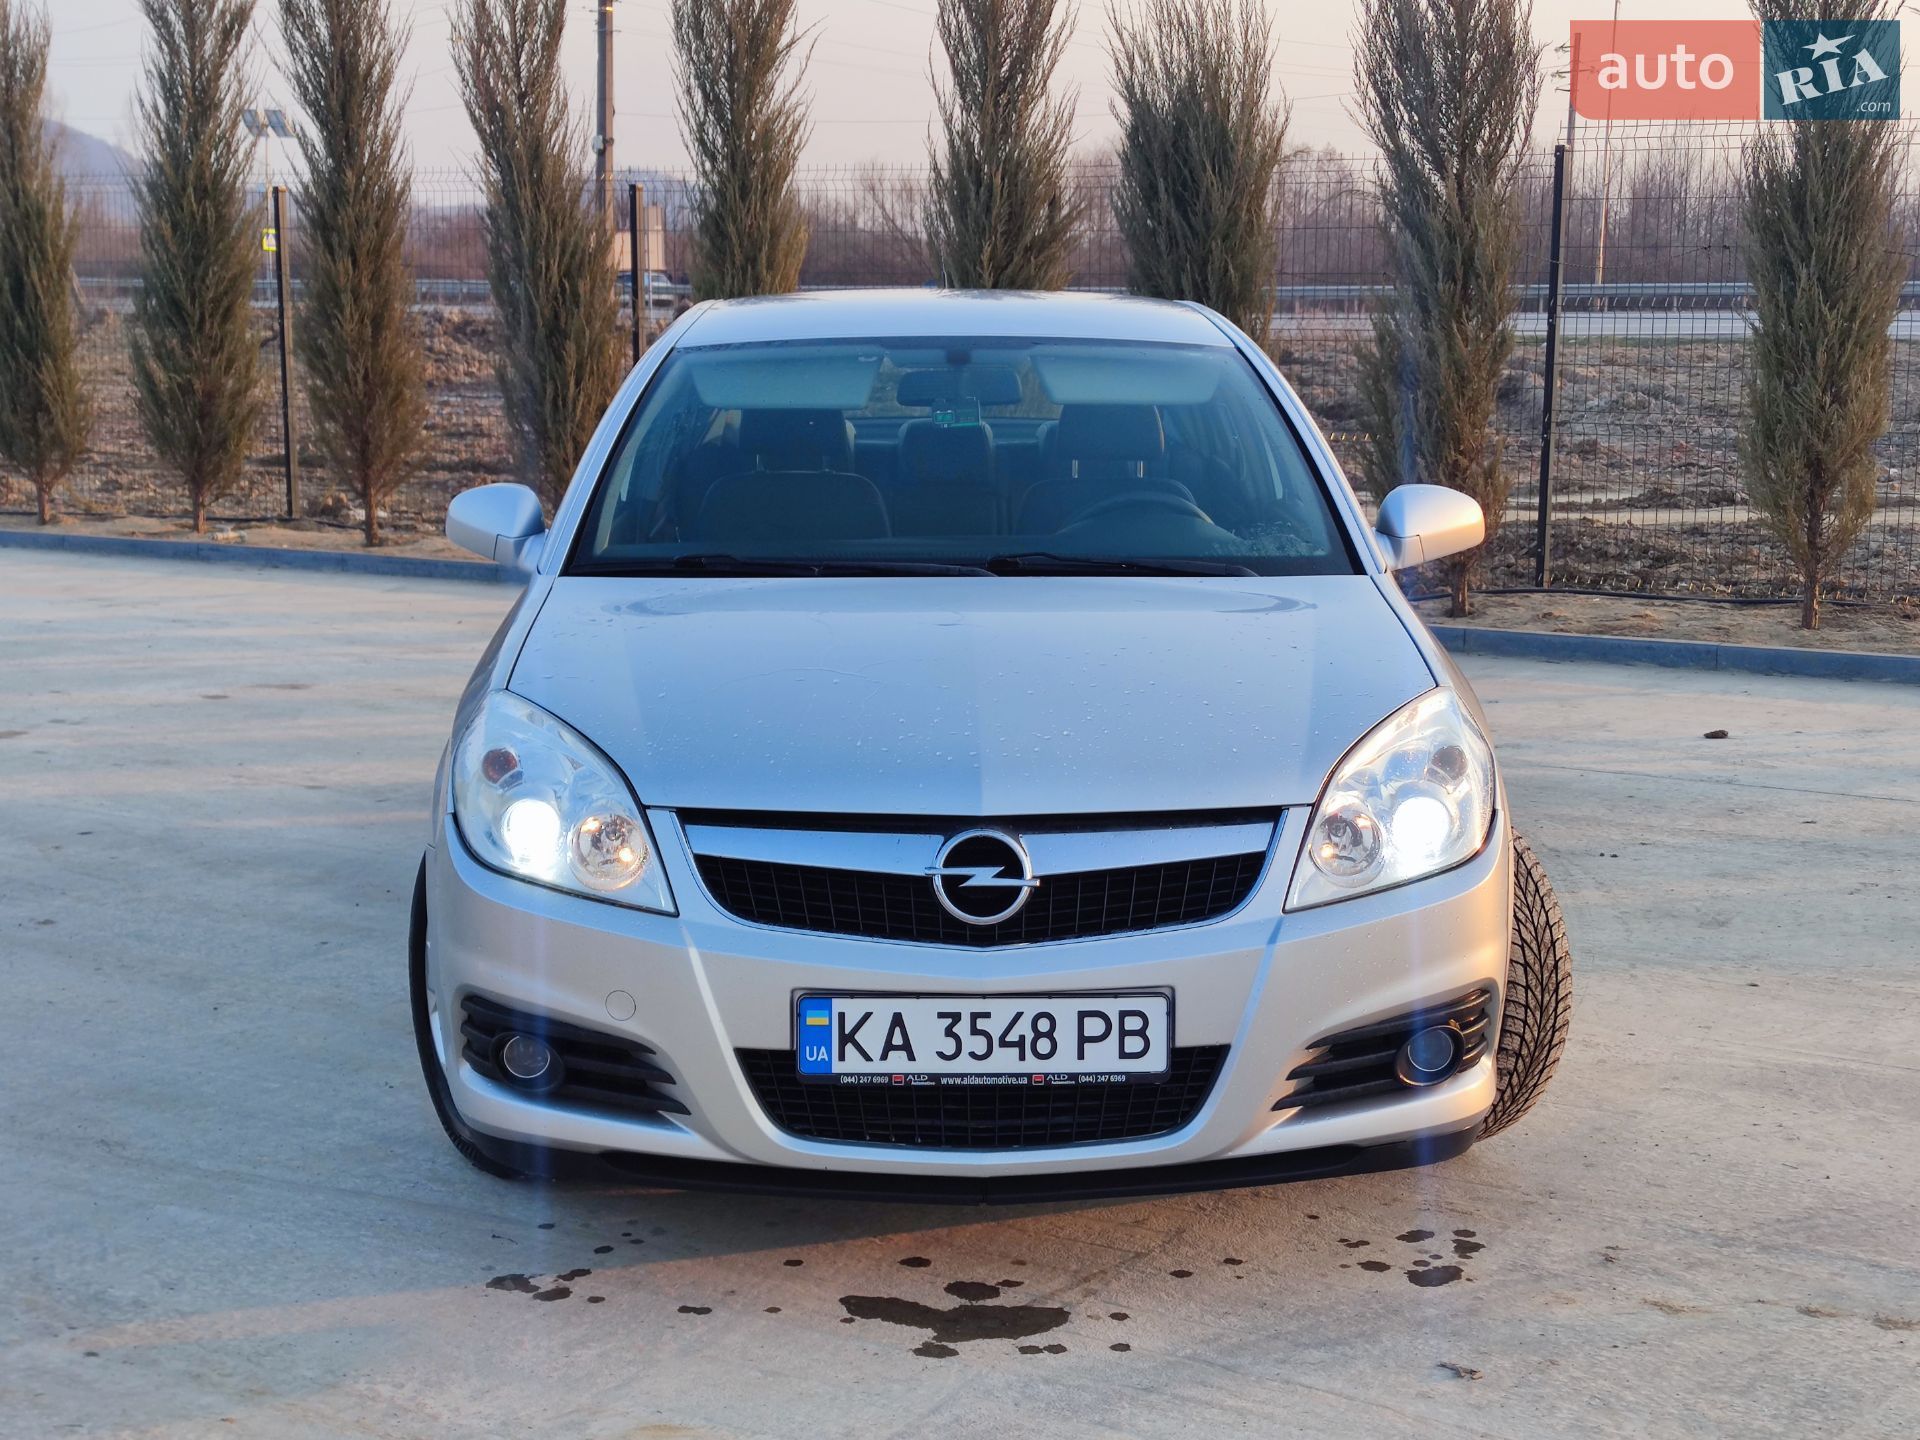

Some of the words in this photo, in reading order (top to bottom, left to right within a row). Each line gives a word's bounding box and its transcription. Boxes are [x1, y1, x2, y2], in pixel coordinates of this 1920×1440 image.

[837, 1011, 917, 1063] KA
[935, 1011, 1058, 1062] 3548
[1076, 1009, 1151, 1061] PB
[805, 1045, 829, 1062] UA
[840, 1074, 858, 1085] (044)
[859, 1075, 872, 1084] 247
[872, 1075, 889, 1084] 6969
[940, 1074, 1028, 1085] www.aldautomotive.ua
[1078, 1074, 1096, 1084] (044)
[1097, 1074, 1109, 1082] 247
[1109, 1074, 1126, 1083] 6969
